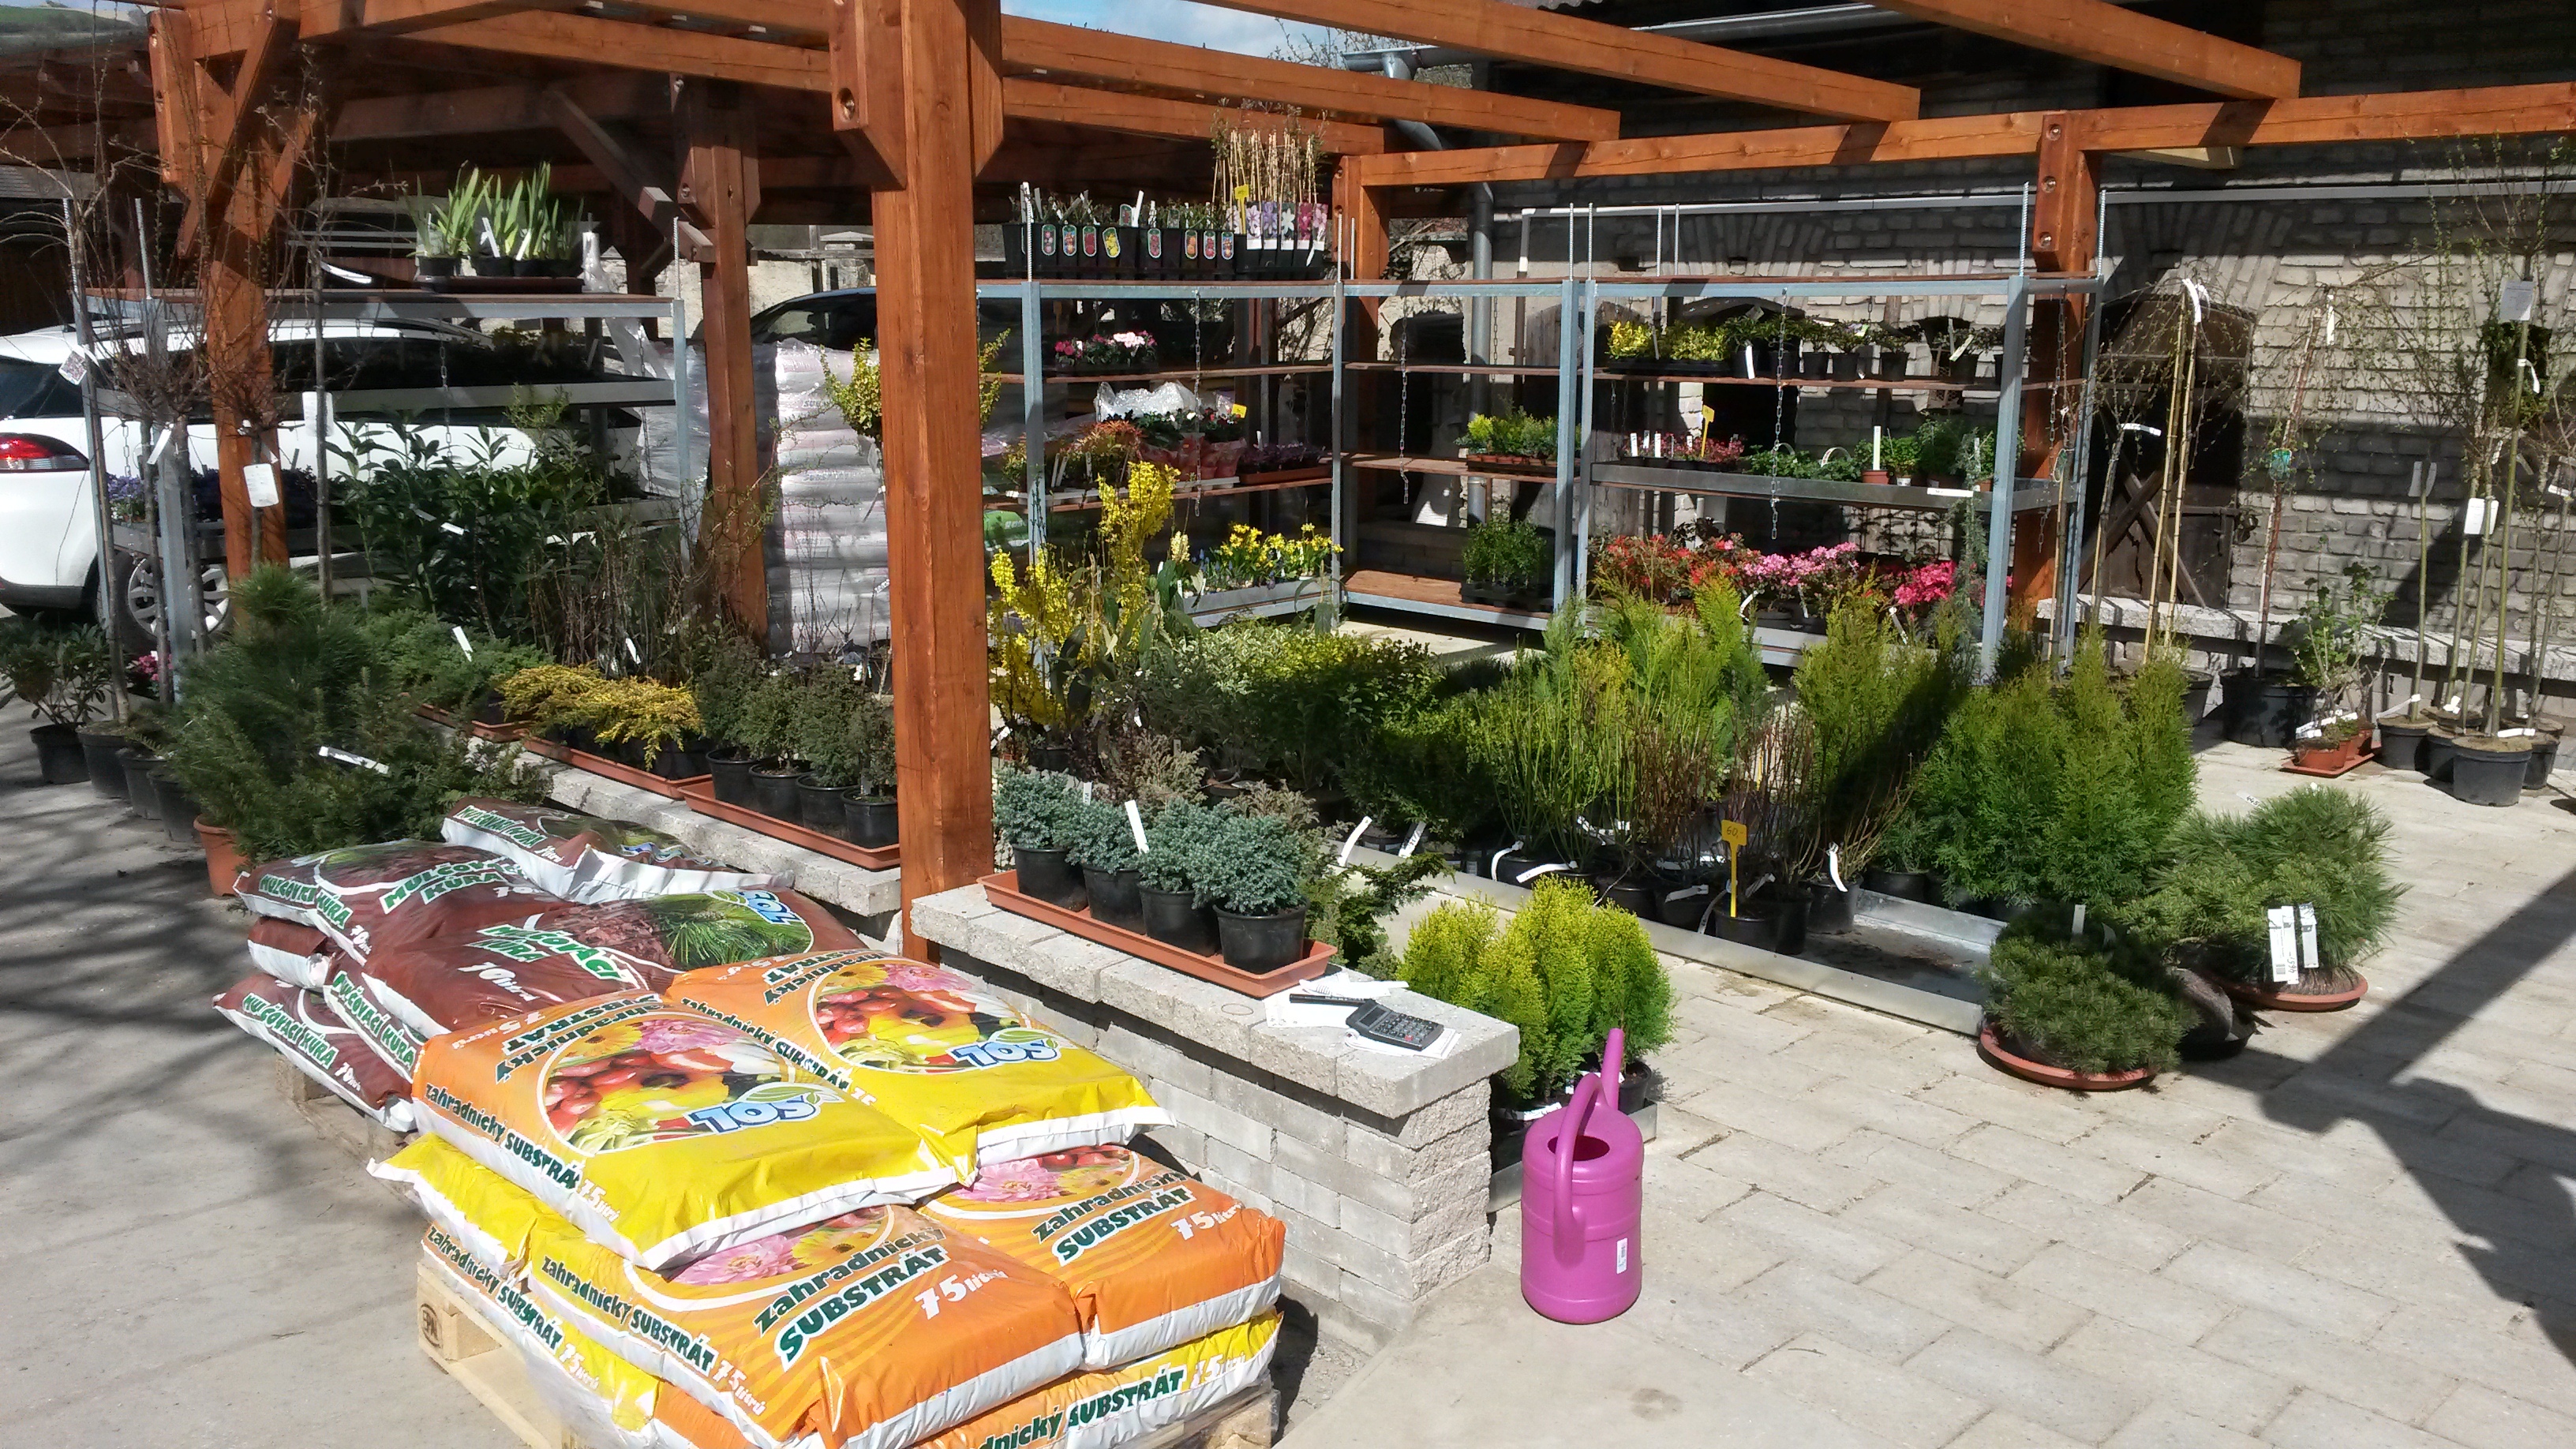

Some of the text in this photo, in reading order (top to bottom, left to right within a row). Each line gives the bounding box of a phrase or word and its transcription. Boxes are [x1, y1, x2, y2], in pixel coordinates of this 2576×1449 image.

[316, 889, 354, 930] KŮRA
[420, 871, 507, 904] KŮRA
[499, 1011, 546, 1035] 75
[298, 1028, 340, 1069] KŮRA
[380, 1024, 417, 1070] KŮRA
[947, 1035, 1060, 1068] SOL
[689, 1094, 819, 1134] SOL
[425, 1083, 506, 1144] zahradnický
[577, 1178, 608, 1204] 75
[1051, 1185, 1197, 1267] SUBSTRÁT
[1170, 1211, 1216, 1241] 75
[426, 1225, 501, 1296] zahradnický
[559, 1342, 585, 1374] 75
[752, 1226, 947, 1338] zahradnický
[914, 1273, 968, 1320] 75
[541, 1255, 633, 1325] zahradnický
[628, 1303, 720, 1378] SUBSTRÁT
[712, 1359, 747, 1391] 75
[773, 1243, 951, 1372] SUBSTRÁT
[978, 1406, 1065, 1449] dnický
[1067, 1361, 1186, 1427] SUBSTRÁT
